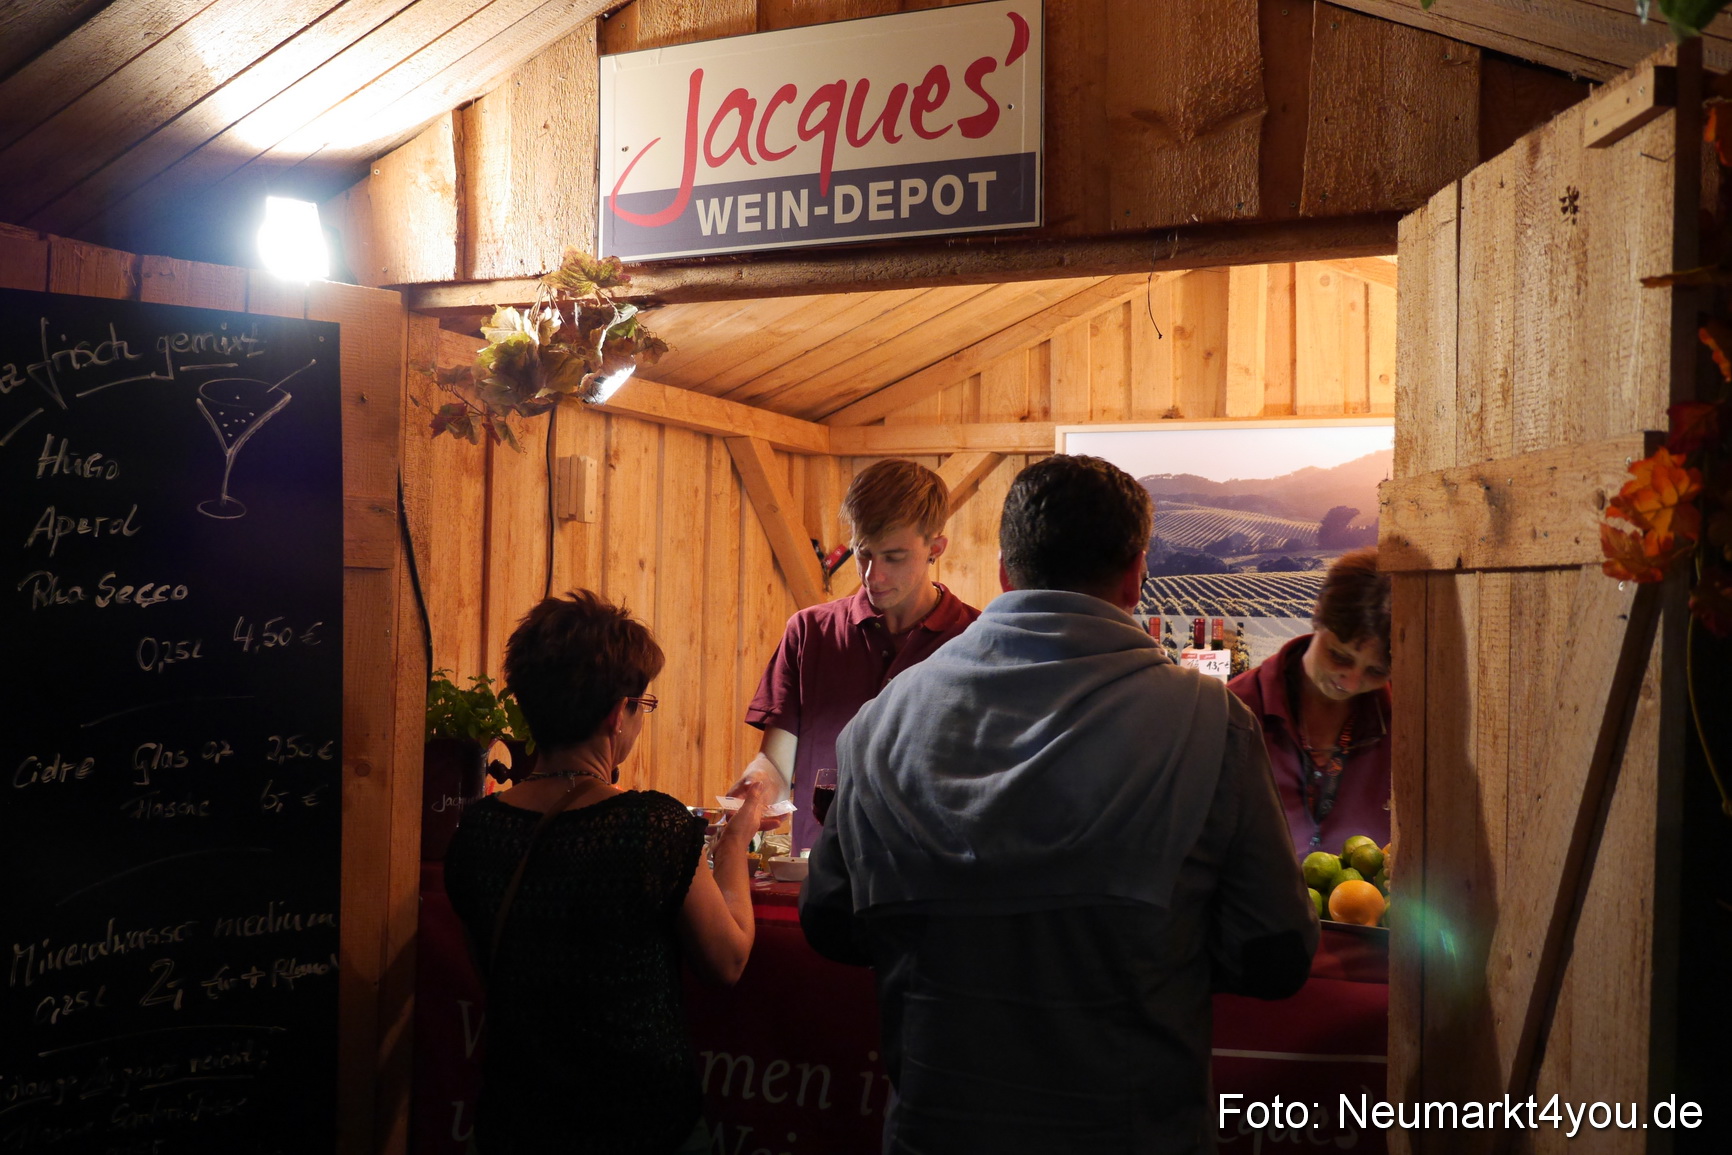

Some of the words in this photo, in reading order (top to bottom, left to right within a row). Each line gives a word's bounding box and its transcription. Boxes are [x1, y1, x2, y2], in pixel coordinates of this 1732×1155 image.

[609, 11, 1030, 228] Jacques'
[695, 170, 998, 237] WEIN-DEPOT
[24, 502, 142, 558] Aperol
[94, 570, 190, 609] Secco
[12, 752, 96, 789] Cidre
[131, 742, 190, 786] Glas
[212, 900, 337, 938] medium
